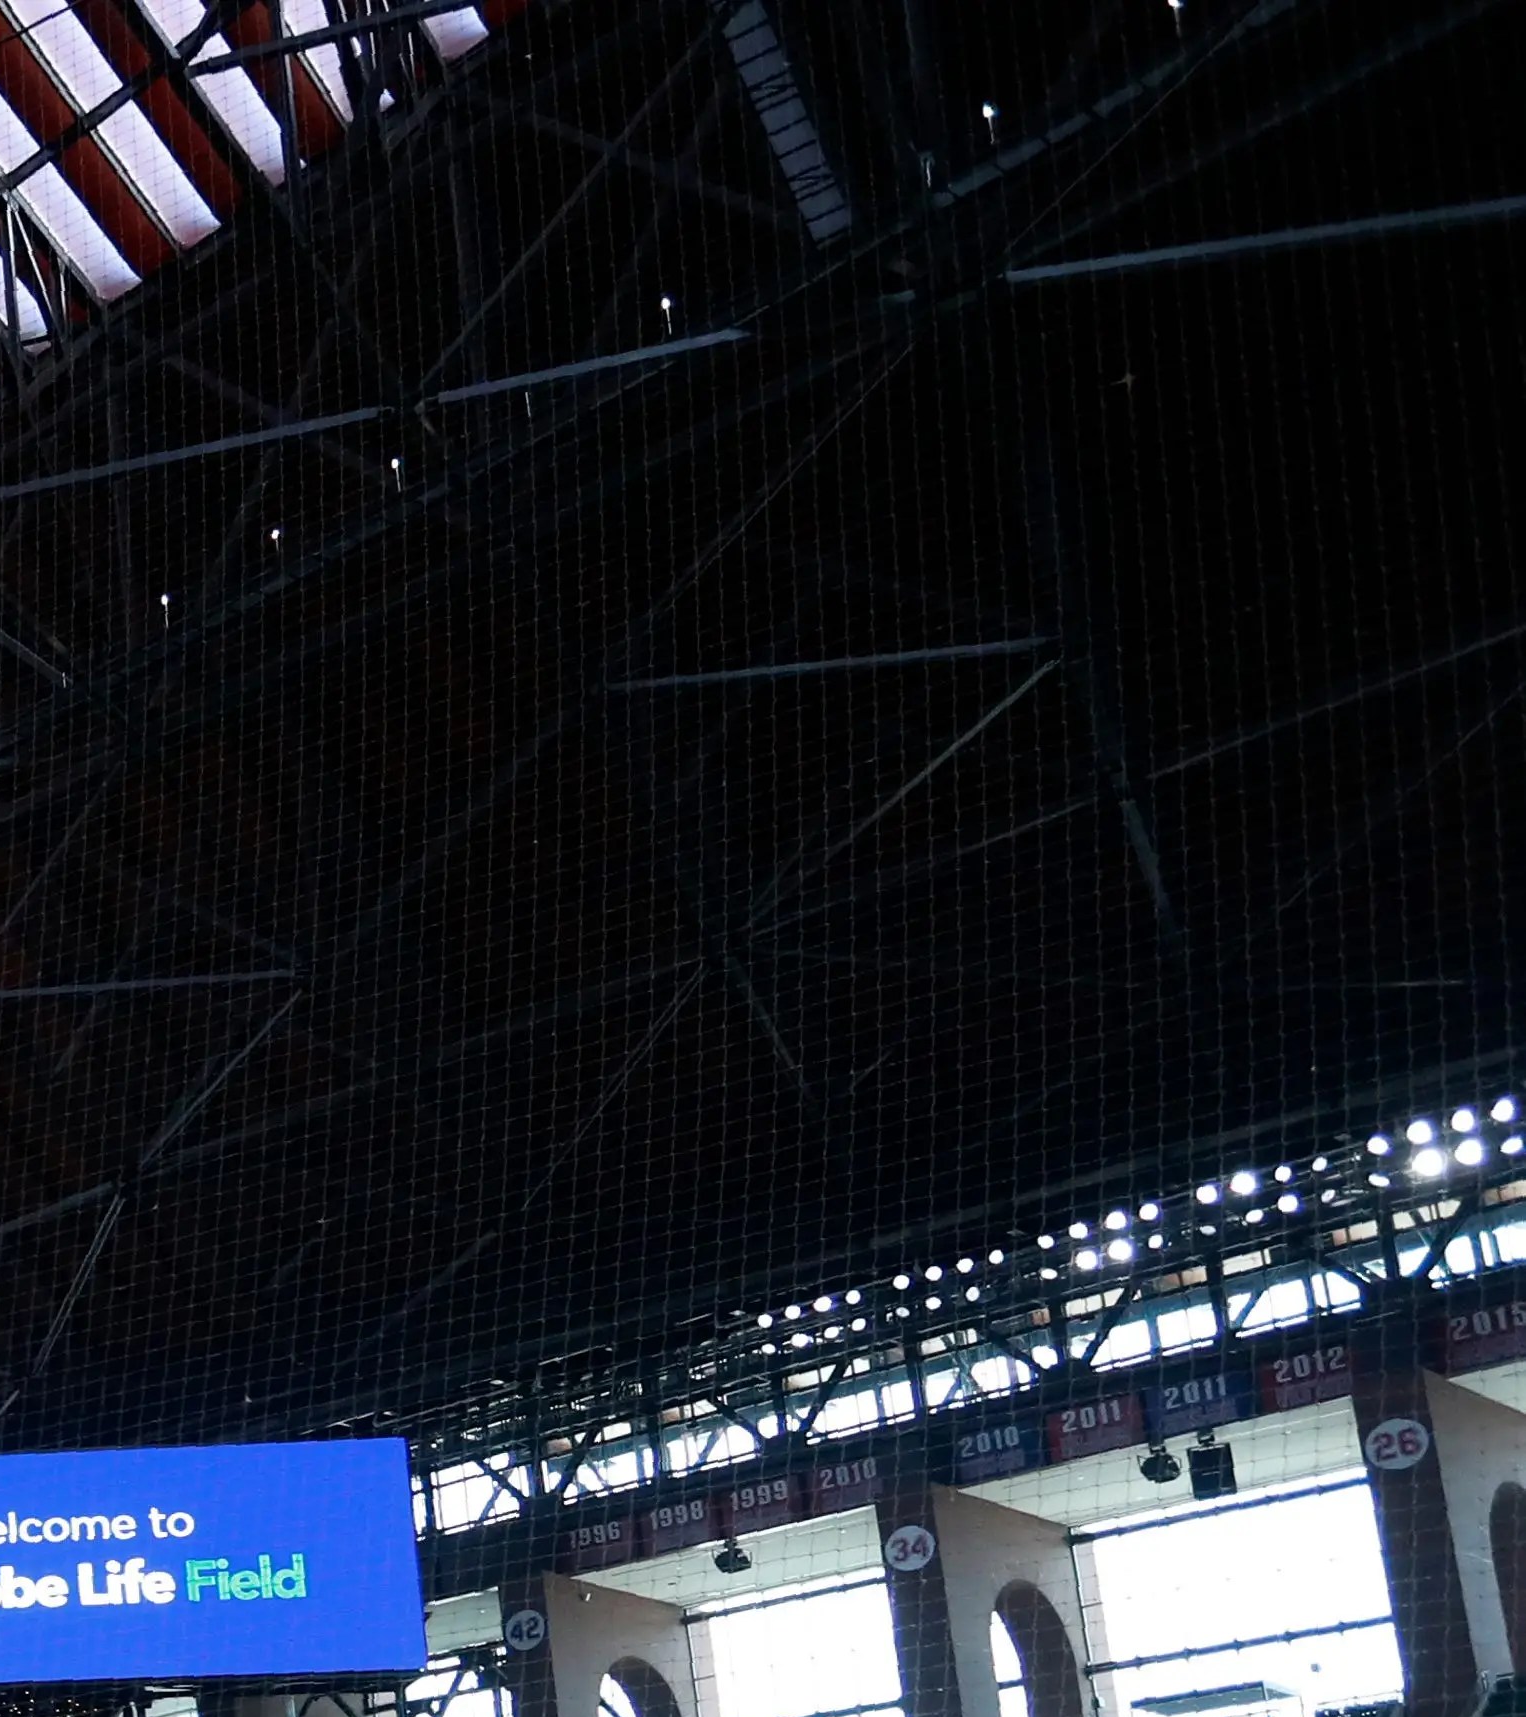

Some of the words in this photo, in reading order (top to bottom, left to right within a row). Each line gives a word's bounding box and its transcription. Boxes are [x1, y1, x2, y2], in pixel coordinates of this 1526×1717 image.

[1273, 1346, 1346, 1383] 2012
[1164, 1373, 1226, 1410] 2011
[1062, 1400, 1121, 1433] 2011
[958, 1426, 1020, 1458] 2010
[1373, 1428, 1421, 1462] 26
[820, 1459, 877, 1490] 2010
[730, 1480, 789, 1511] 1999
[149, 1506, 195, 1539] to
[650, 1501, 705, 1531] 1998
[889, 1532, 930, 1563] 34
[78, 1559, 176, 1607] Life
[187, 1553, 308, 1602] Field
[511, 1614, 542, 1643] 42
